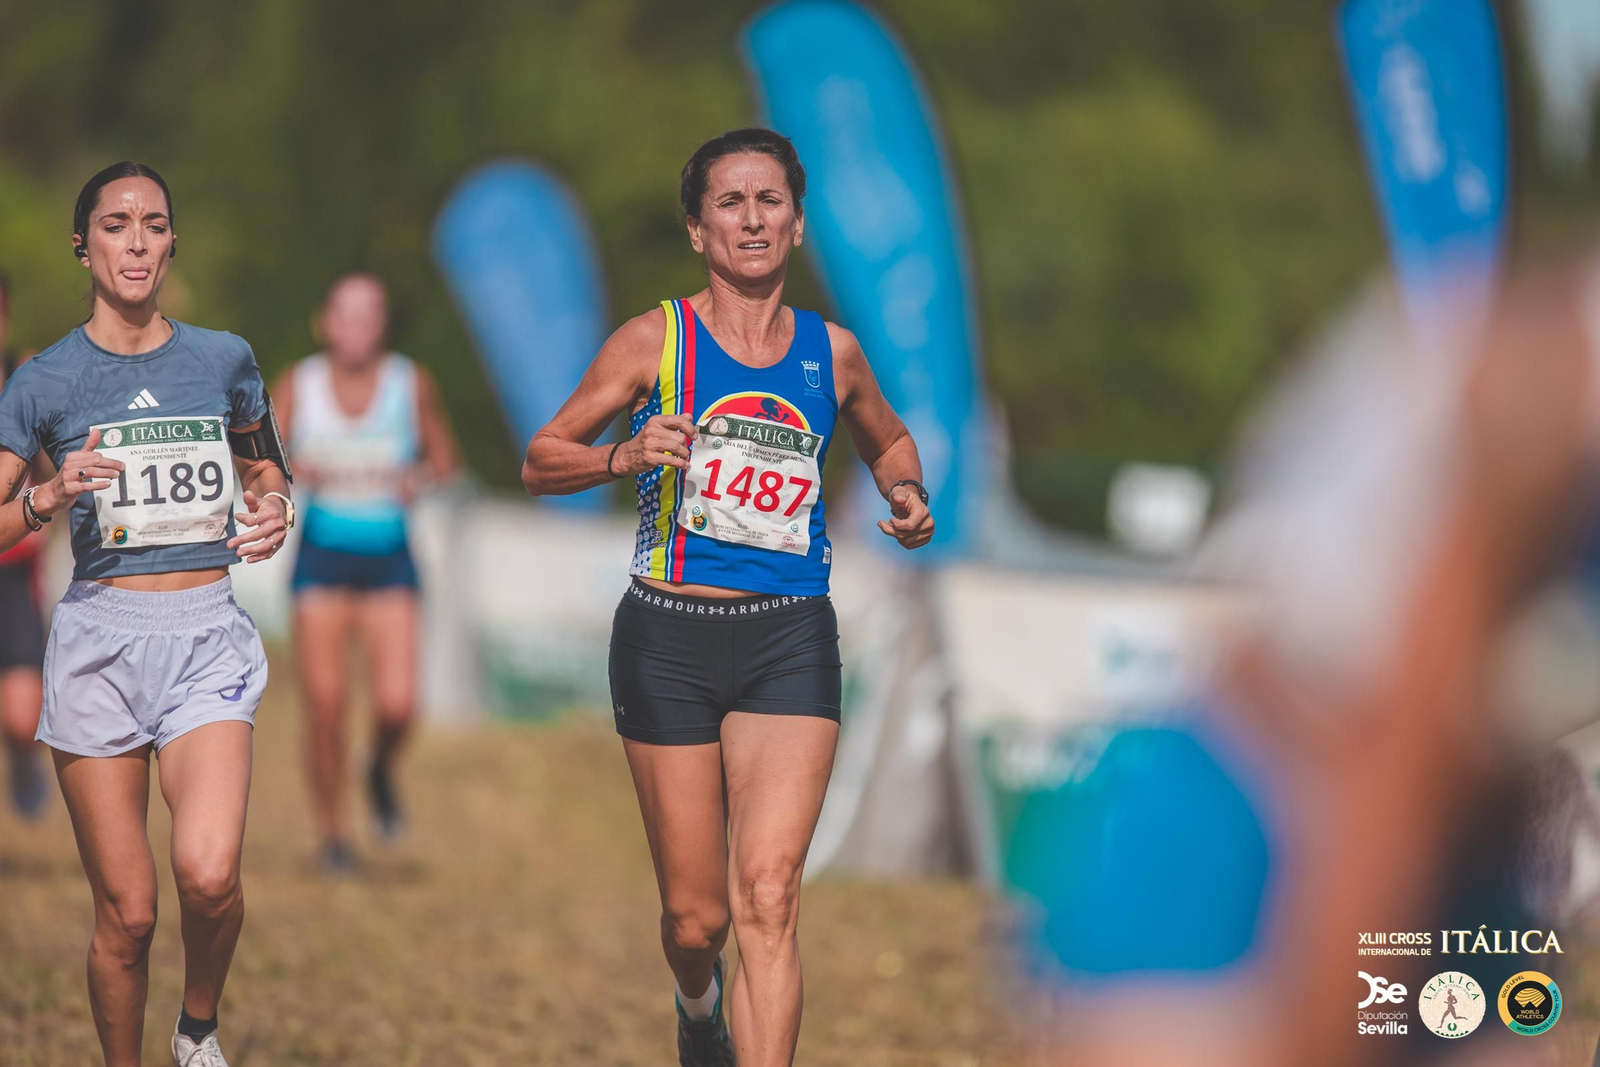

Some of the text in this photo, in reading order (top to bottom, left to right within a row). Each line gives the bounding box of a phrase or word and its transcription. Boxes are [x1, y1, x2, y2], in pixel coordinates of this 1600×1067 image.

[131, 423, 193, 441] ITÁLICA
[737, 424, 794, 446] ITÁLICA
[111, 461, 224, 508] 1189
[701, 459, 812, 517] 1487
[644, 593, 790, 615] ARMOUR ARMOUR
